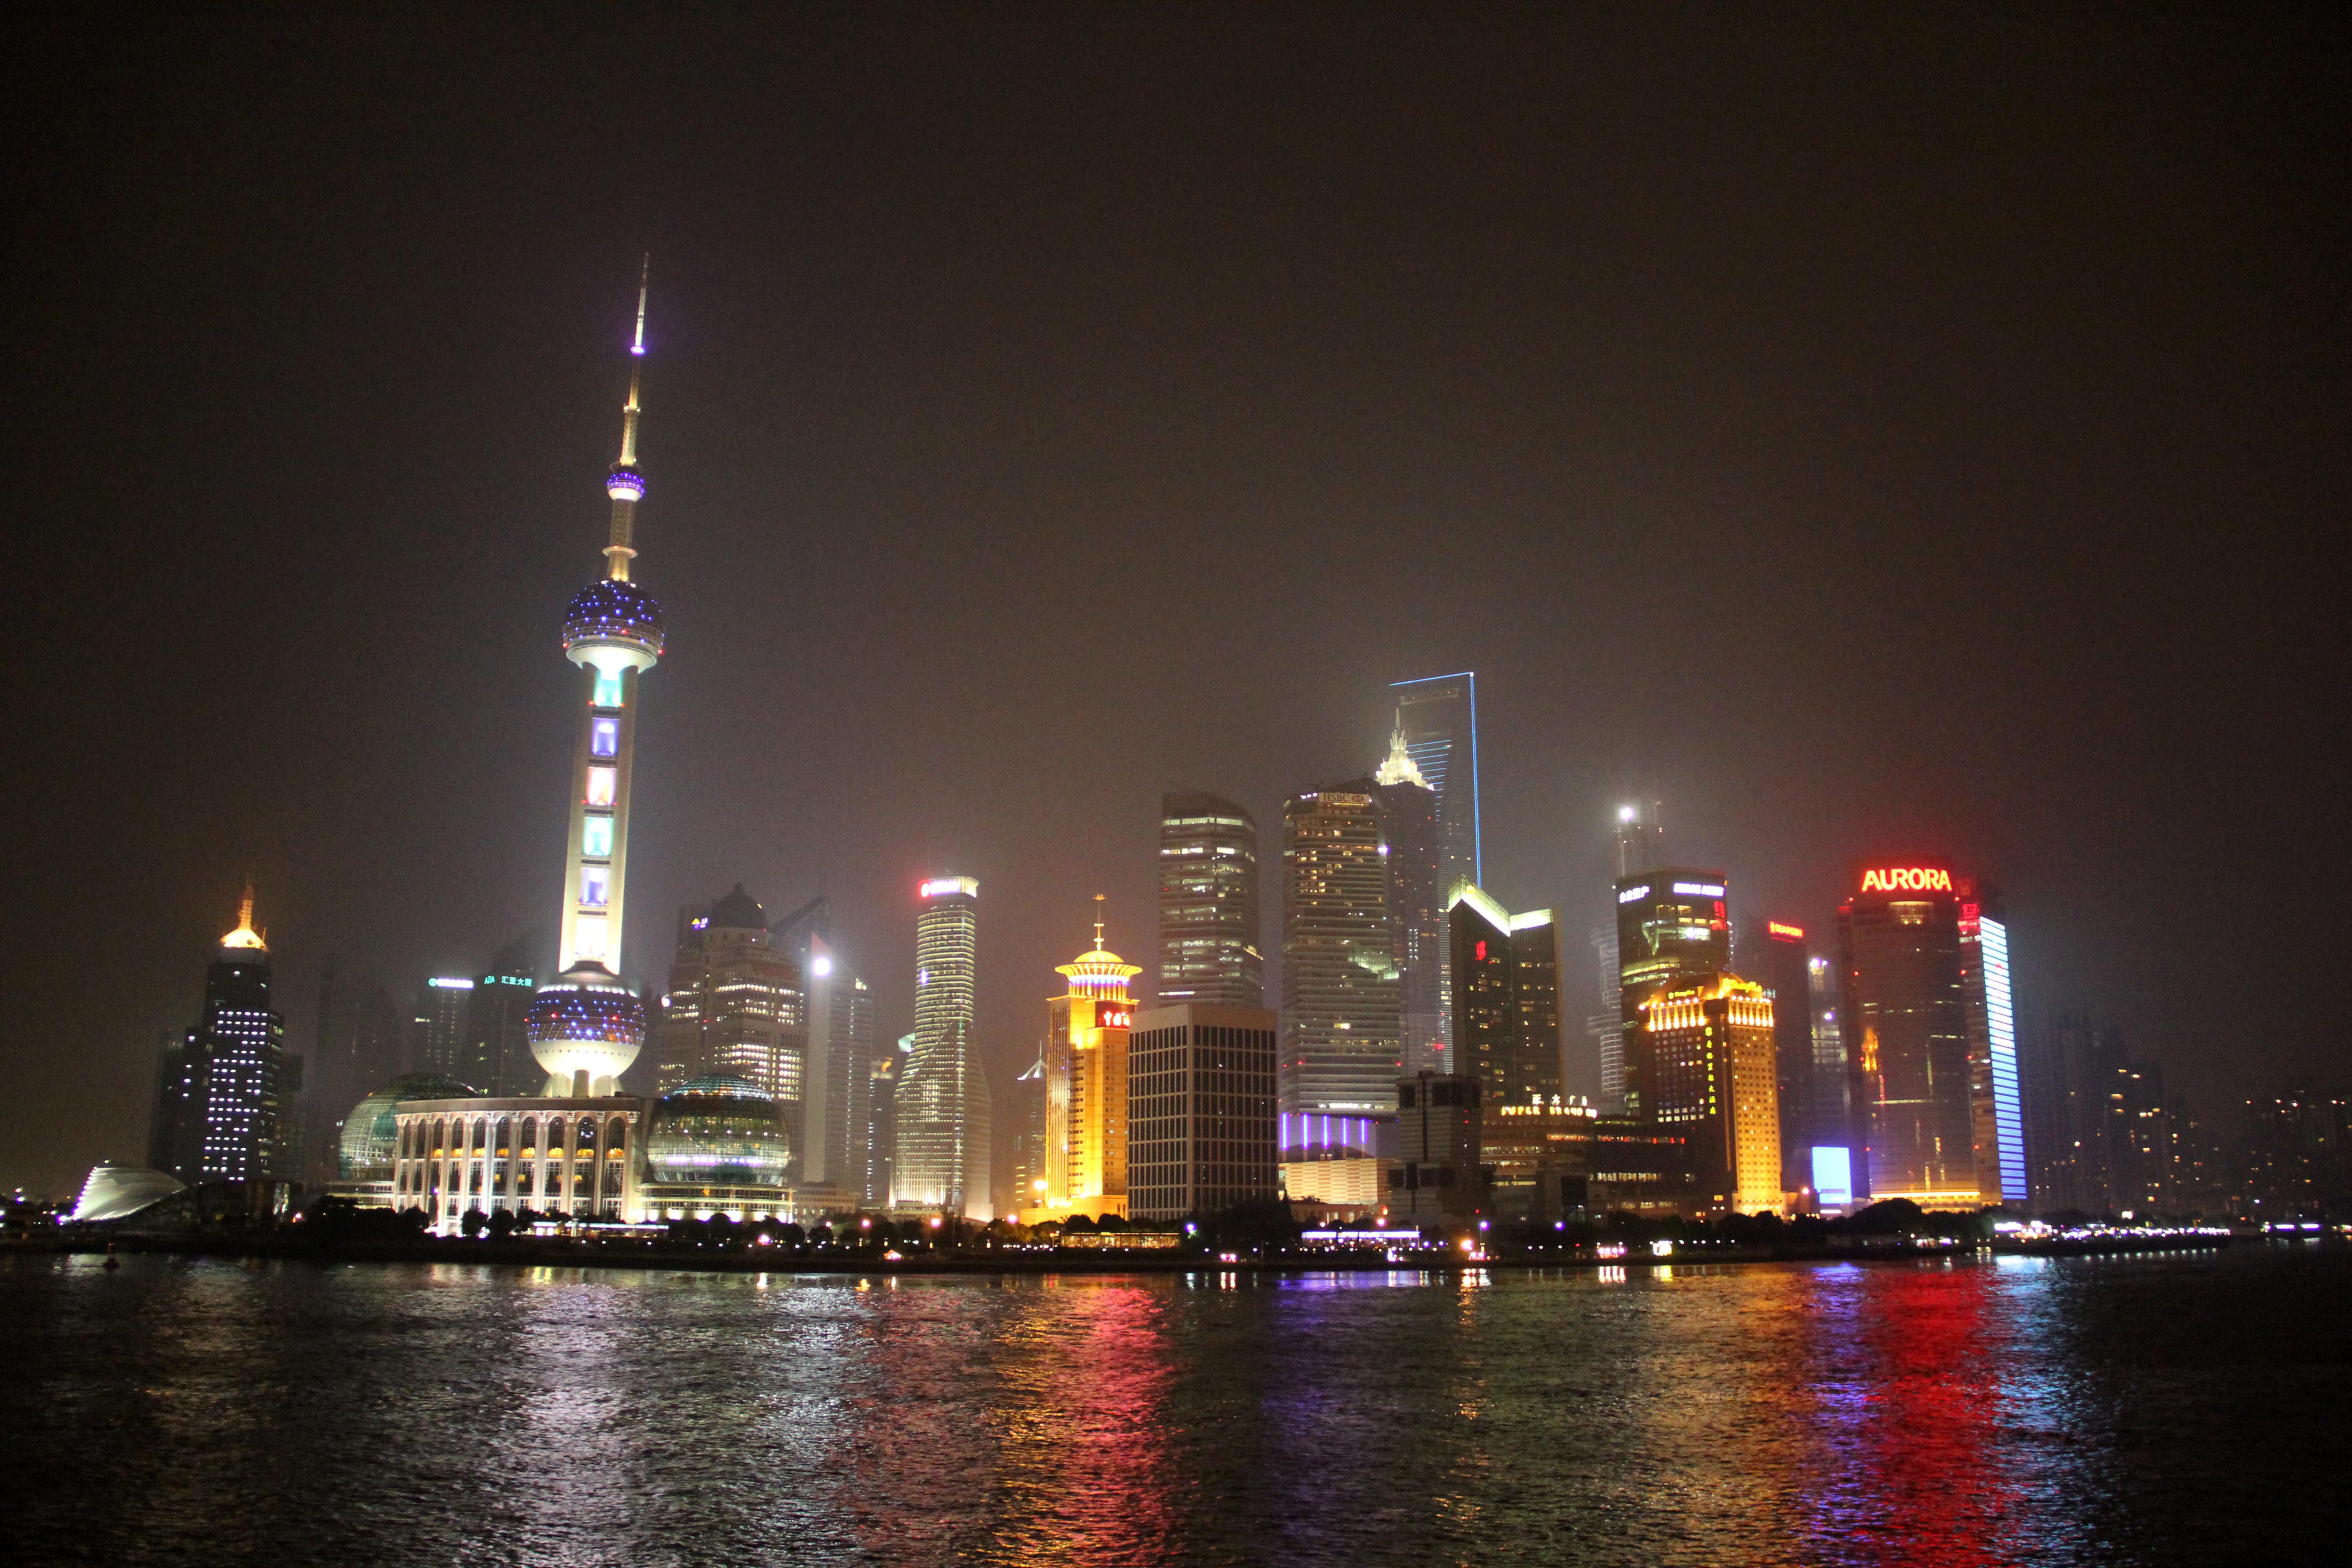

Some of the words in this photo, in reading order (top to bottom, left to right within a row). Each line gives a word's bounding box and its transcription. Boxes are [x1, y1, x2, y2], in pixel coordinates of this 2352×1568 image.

[1323, 794, 1349, 802] HSBC
[1861, 868, 1952, 892] AURORA
[484, 975, 495, 985] AZIA
[501, 976, 533, 987] 汇亚大厦
